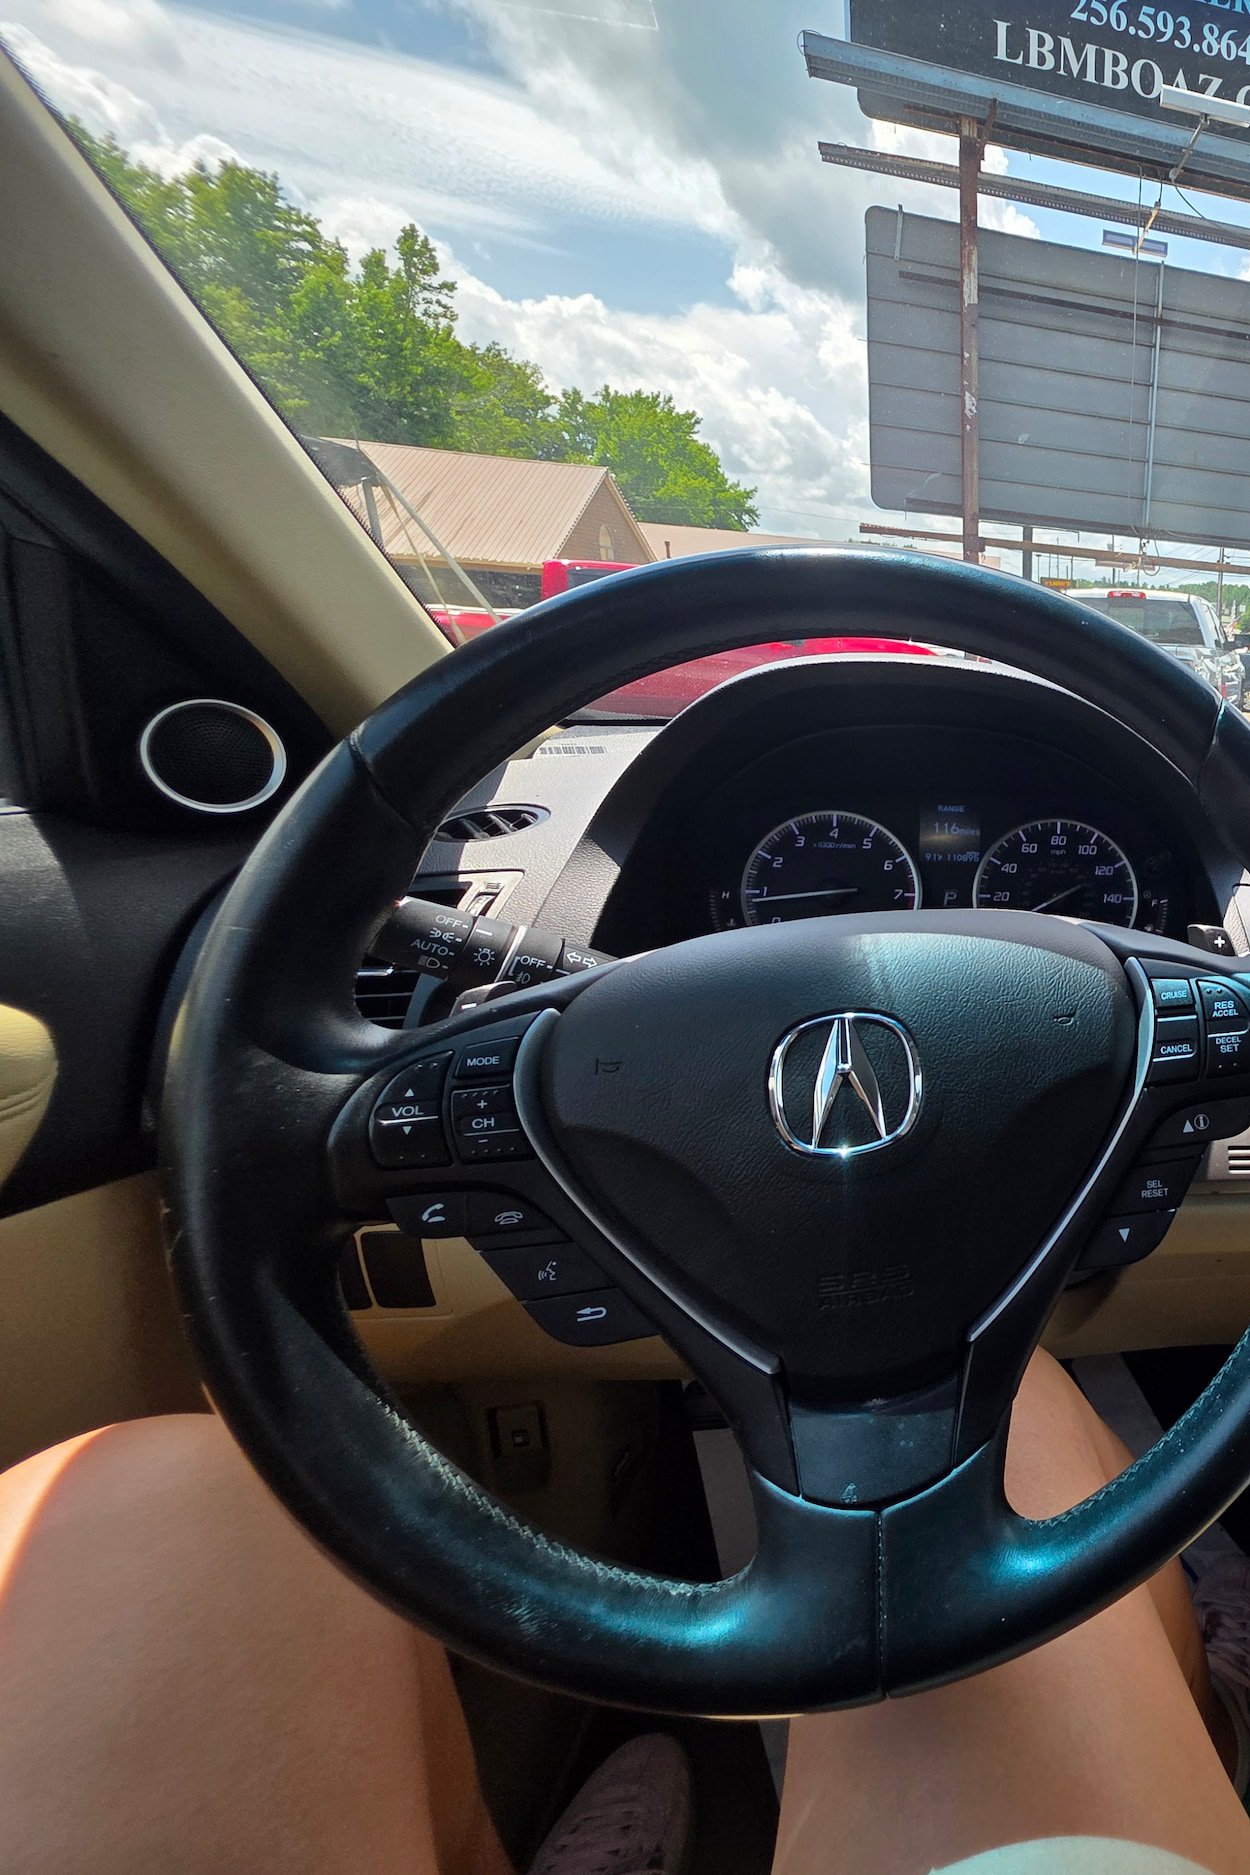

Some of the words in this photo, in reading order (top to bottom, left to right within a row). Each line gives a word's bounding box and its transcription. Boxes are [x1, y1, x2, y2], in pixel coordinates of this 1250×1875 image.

[937, 804, 965, 813] RANGE
[829, 828, 839, 839] 4
[934, 822, 959, 835] 116
[795, 836, 806, 847] 3
[862, 838, 873, 849] 5
[1050, 835, 1067, 846] 80
[1021, 843, 1038, 853] 60
[1078, 844, 1098, 855] 100
[772, 857, 783, 868] 2
[884, 861, 893, 871] 6
[1001, 863, 1018, 874] 40
[1094, 865, 1114, 876] 120
[721, 890, 730, 899] H
[762, 886, 768, 897] 1
[894, 889, 903, 900] 7
[993, 891, 1010, 901] 20
[944, 891, 957, 906] P
[1103, 893, 1122, 904] 140
[435, 914, 463, 928] OFF
[410, 938, 449, 956] AUTO
[520, 955, 547, 969] OFF
[1160, 989, 1187, 1000] CRUISE
[1214, 1000, 1234, 1010] RES
[1212, 1009, 1239, 1017] ACCEL
[1215, 1036, 1242, 1045] DECEL
[1160, 1043, 1193, 1055] CANCEL
[1220, 1043, 1239, 1053] SET
[466, 1055, 500, 1067] MODE
[392, 1105, 424, 1117] VOL
[471, 1117, 495, 1129] CH
[1146, 1180, 1163, 1189] SEL
[1141, 1187, 1169, 1198] RESET
